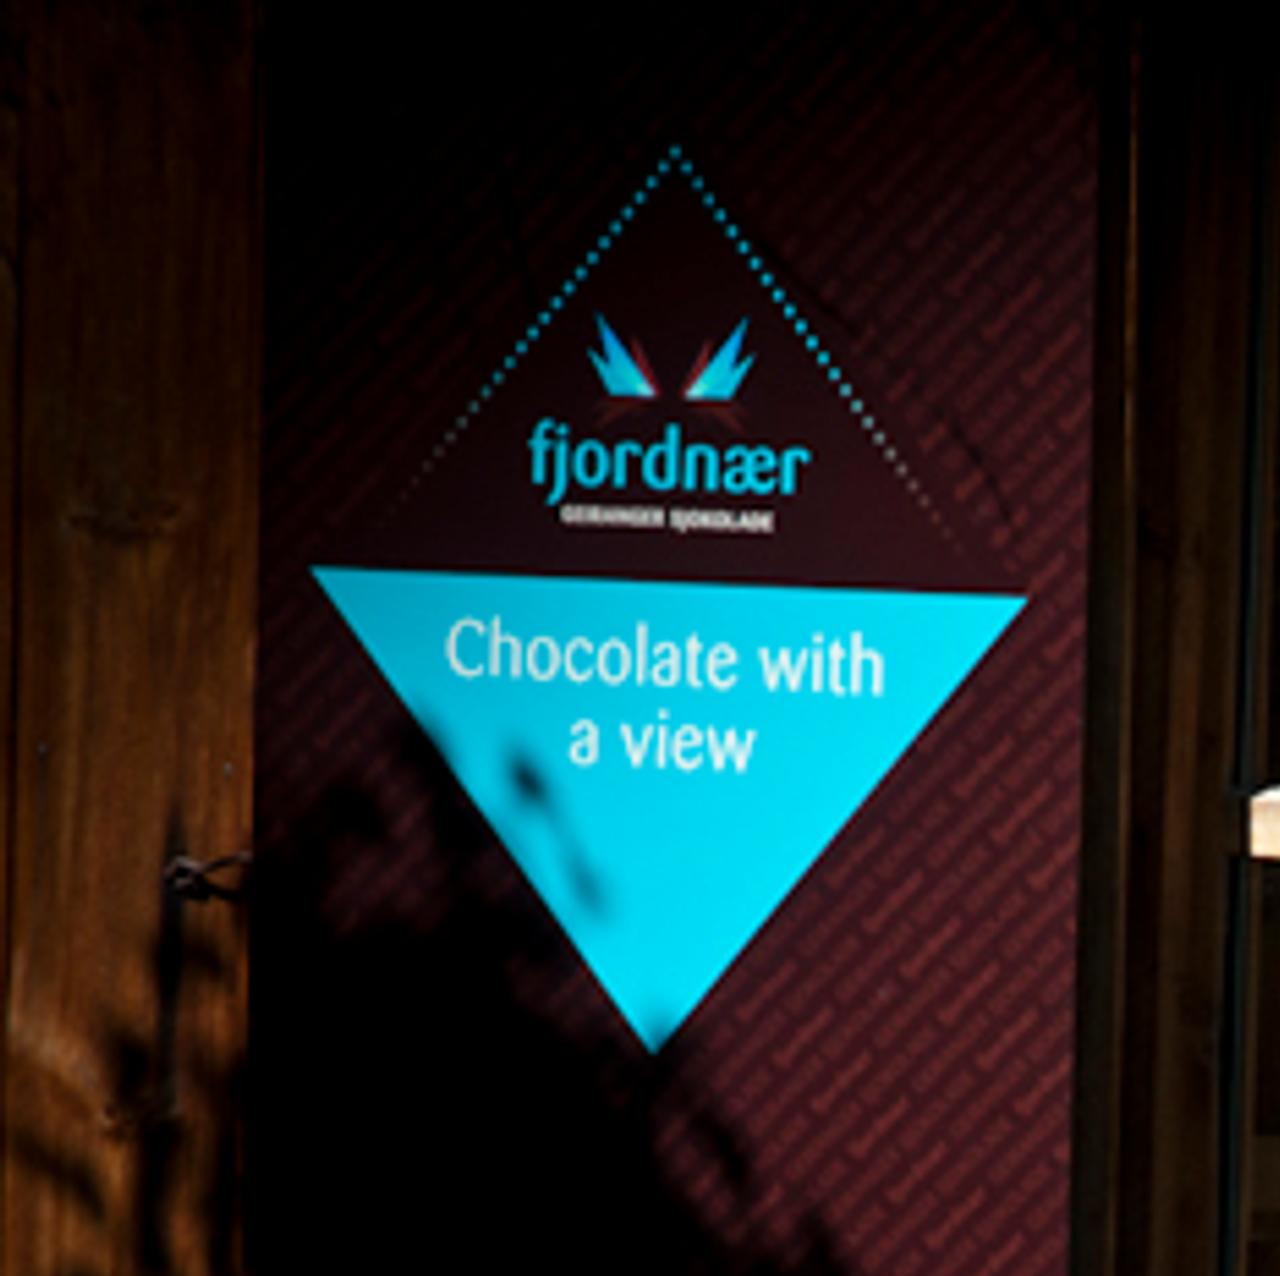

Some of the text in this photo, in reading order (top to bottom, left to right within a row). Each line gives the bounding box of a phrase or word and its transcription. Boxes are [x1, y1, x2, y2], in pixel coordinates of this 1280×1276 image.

[528, 419, 812, 506] fjordnær
[446, 617, 885, 696] Chocolate with
[568, 709, 757, 772] a view
